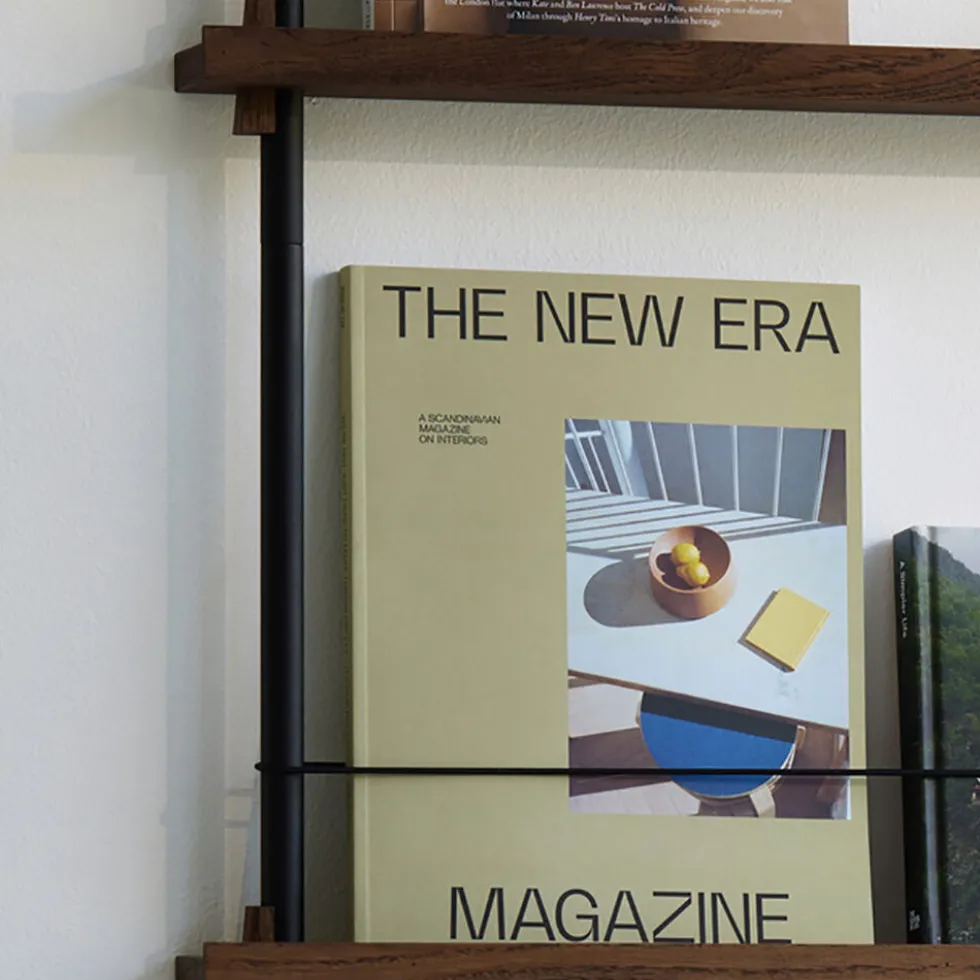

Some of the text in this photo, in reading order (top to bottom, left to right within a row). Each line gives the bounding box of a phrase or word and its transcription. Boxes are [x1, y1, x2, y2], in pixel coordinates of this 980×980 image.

[507, 0, 530, 8] where
[551, 0, 565, 8] and
[634, 2, 649, 12] The
[650, 3, 666, 12] Cold
[688, 5, 702, 13] and
[507, 11, 516, 20] of
[516, 11, 540, 21] Milan
[541, 12, 573, 23] through
[575, 13, 598, 25] Henry
[622, 14, 652, 26] homage
[654, 16, 663, 24] to
[664, 15, 689, 25] Italian
[382, 285, 508, 342] THE
[536, 290, 684, 347] NEW
[713, 297, 841, 355] ERA
[419, 413, 501, 424] A SCANDINAVIAN
[419, 424, 471, 434] MAGAZINE
[419, 434, 488, 446] ON INTERIORS
[450, 886, 792, 944] MAGAZINE
